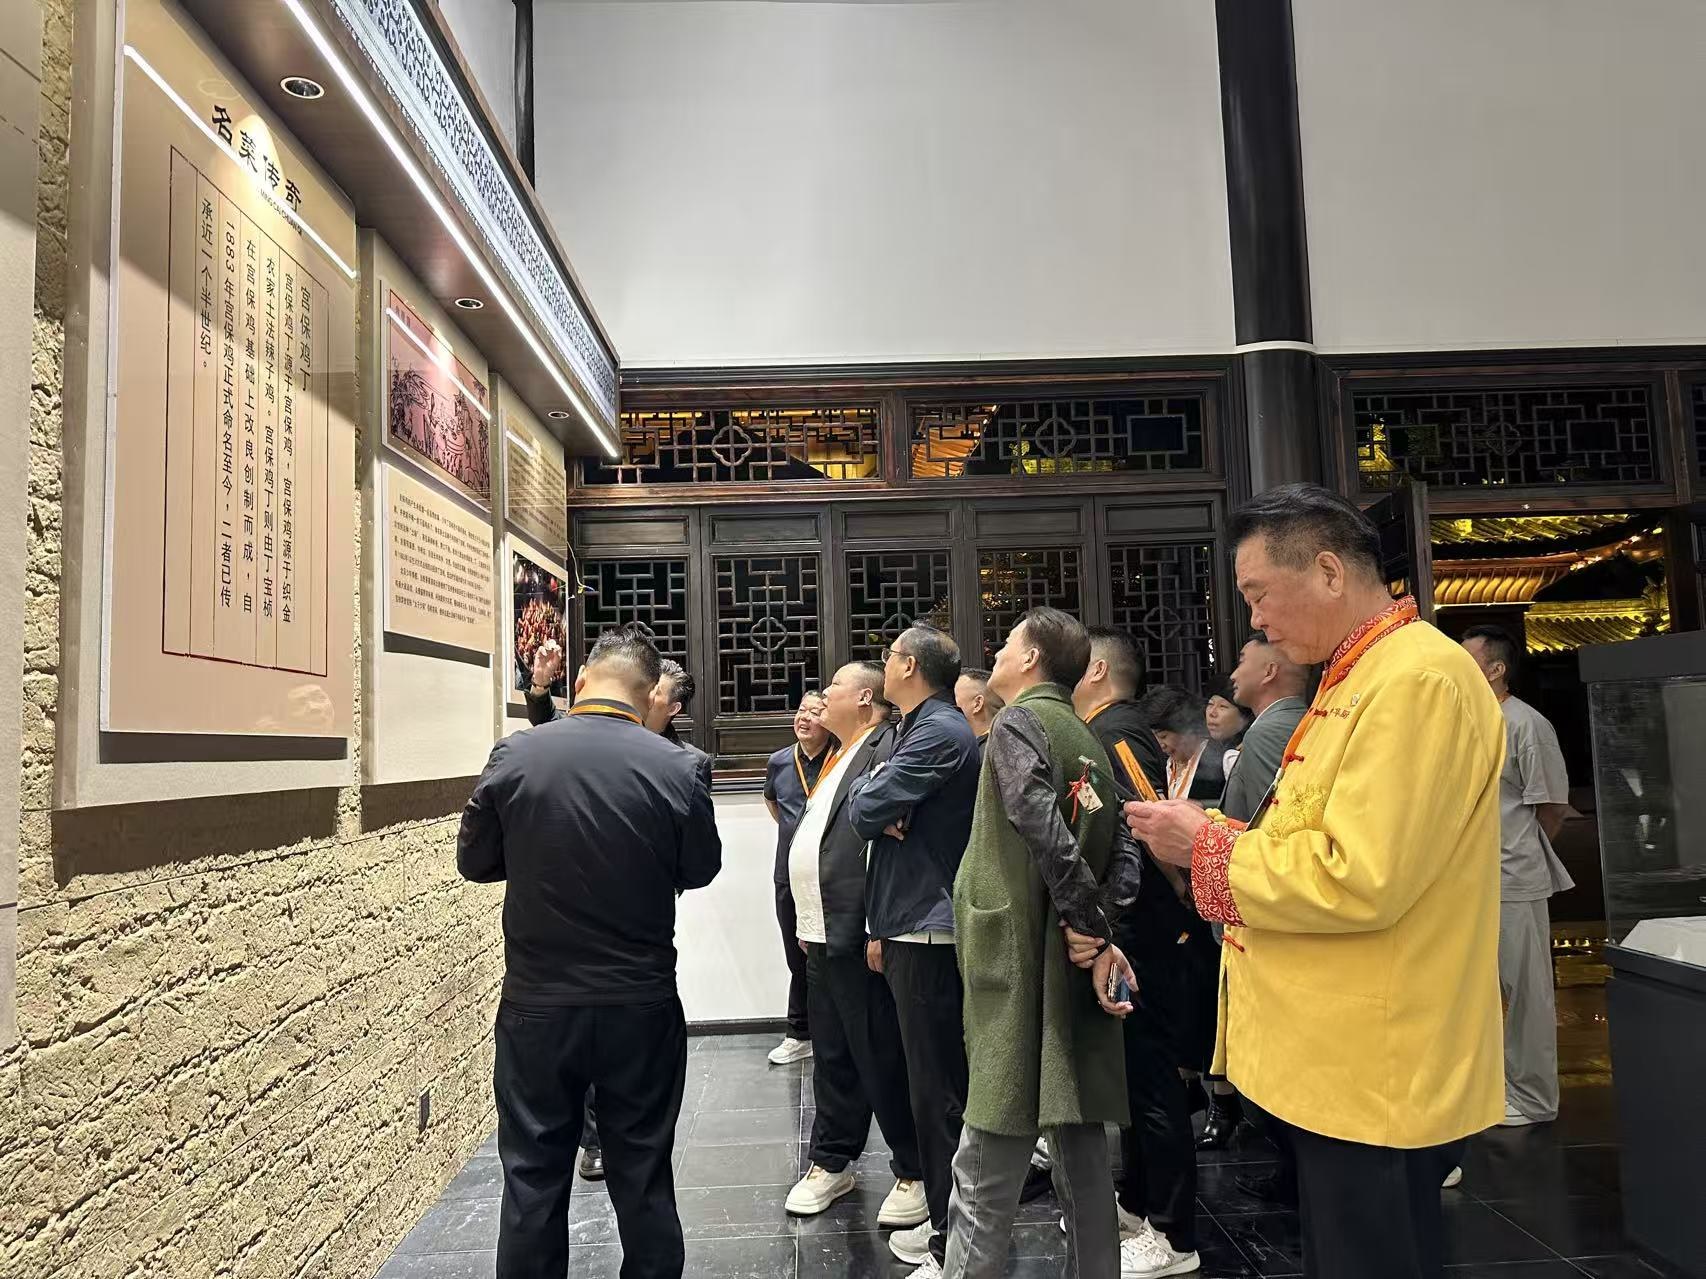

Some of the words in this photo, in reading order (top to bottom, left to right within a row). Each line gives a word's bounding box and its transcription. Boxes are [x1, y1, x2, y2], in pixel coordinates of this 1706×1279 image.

[211, 104, 302, 211] 名菜传奇
[300, 286, 312, 392] 宫保鸡丁
